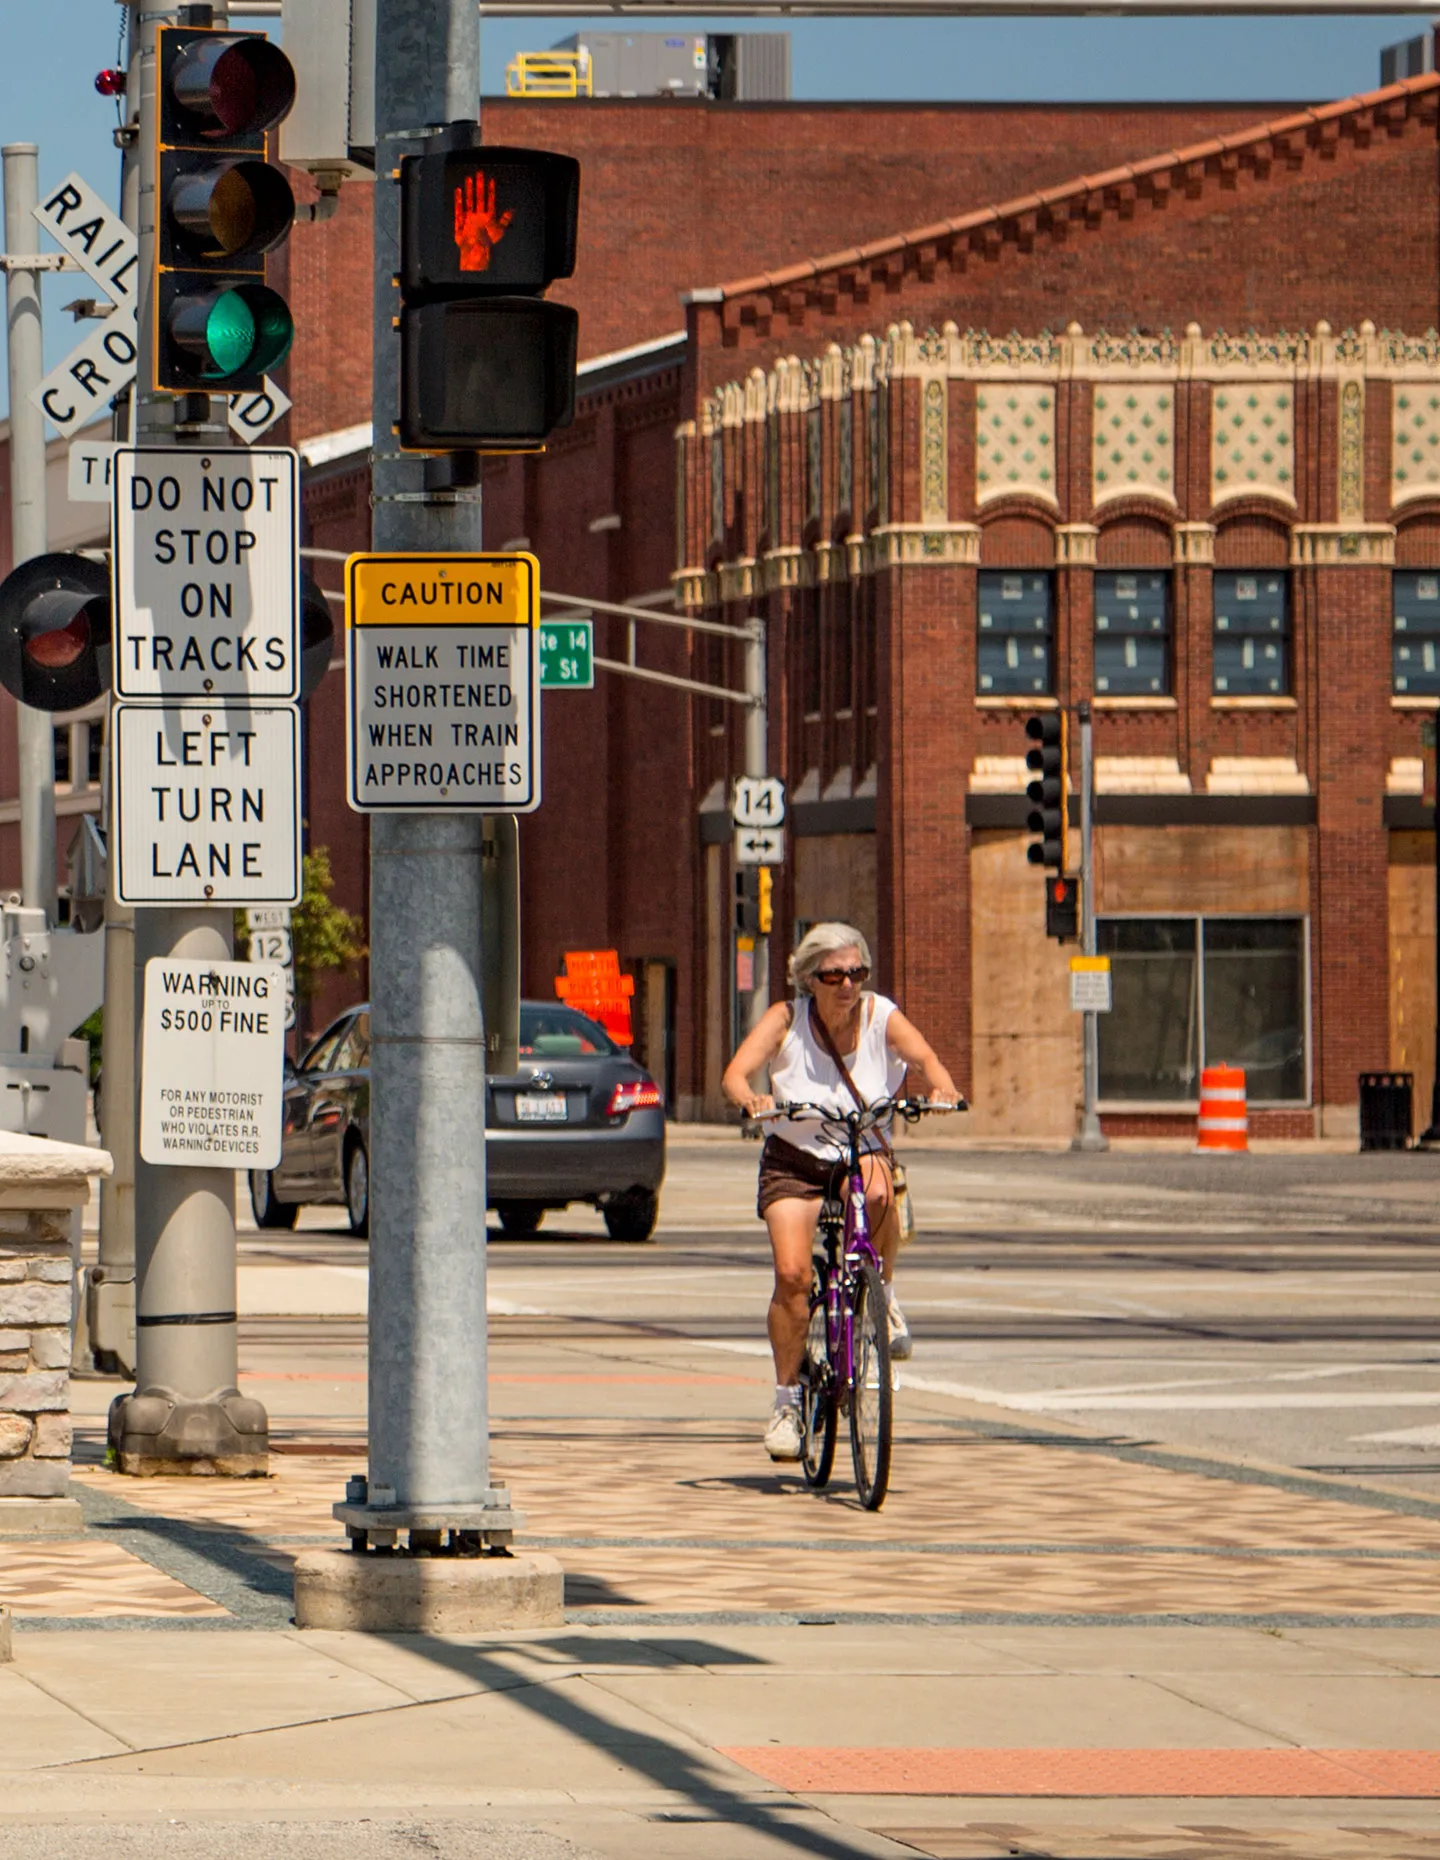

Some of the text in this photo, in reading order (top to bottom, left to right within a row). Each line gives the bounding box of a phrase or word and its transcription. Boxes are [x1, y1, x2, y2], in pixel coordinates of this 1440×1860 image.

[44, 183, 138, 294] RAIL
[130, 477, 279, 512] DO NOT
[154, 529, 257, 566] STOP
[180, 583, 233, 618] ON
[380, 581, 504, 605] CAUTION
[569, 630, 587, 652] 14
[127, 635, 286, 672] TRACKS
[376, 645, 509, 669] WALK TIME
[374, 684, 512, 708] SHORTENED
[369, 723, 519, 748] WHEN TRAIN
[156, 731, 257, 767] LEFT
[365, 763, 522, 787] APPROACHES
[152, 787, 264, 822] TURN
[744, 790, 773, 816] 14
[152, 842, 263, 878] LANE
[254, 910, 284, 925] WEST
[257, 937, 284, 960] 12
[162, 972, 269, 998] WARNING
[201, 999, 230, 1010] UP TO
[160, 1008, 269, 1034] $500 FINE
[161, 1089, 264, 1106] FOR ANY MOTORIST
[170, 1106, 254, 1121] OR PEDESTRIAN
[161, 1122, 261, 1138] WHO VIOLATES R.R.
[163, 1138, 260, 1153] WARNING DEVICES
